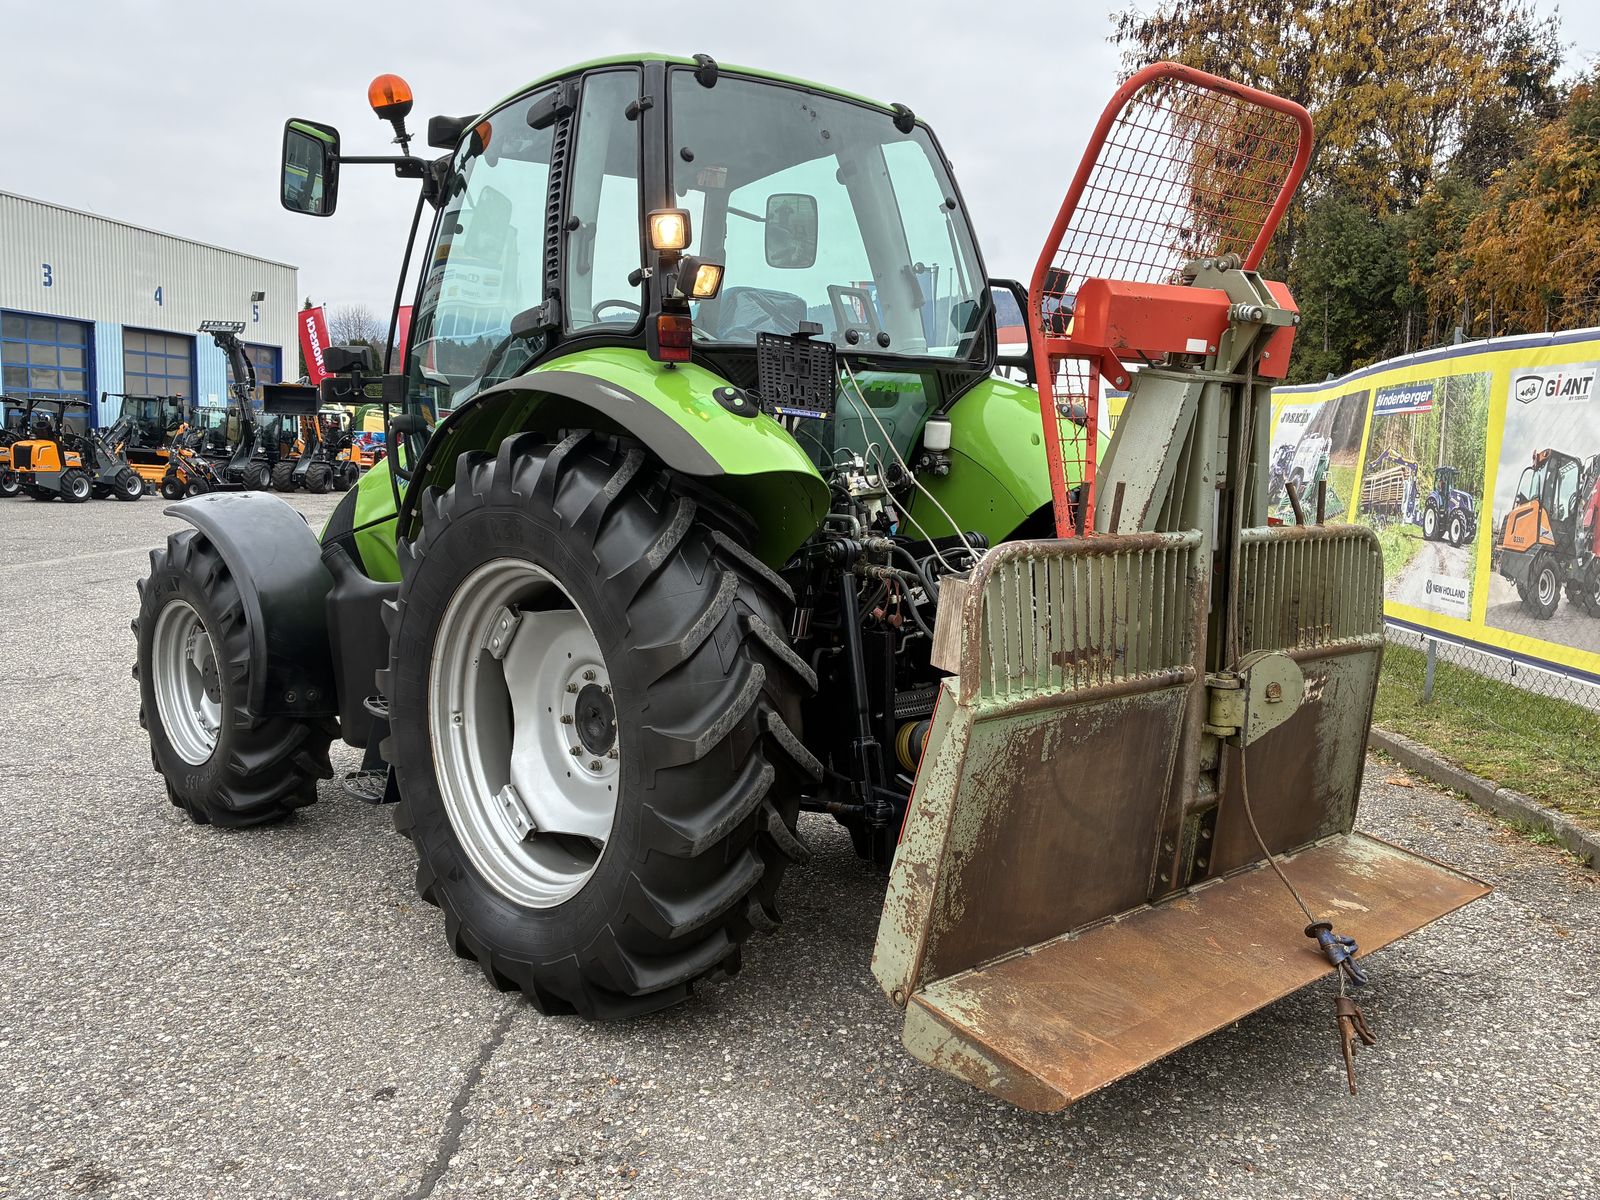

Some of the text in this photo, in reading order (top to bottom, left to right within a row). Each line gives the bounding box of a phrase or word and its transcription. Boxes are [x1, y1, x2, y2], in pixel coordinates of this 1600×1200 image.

[42, 264, 52, 287] 3
[154, 286, 163, 306] 4
[253, 305, 259, 323] 5
[1376, 390, 1431, 406] Binderberger
[1433, 584, 1465, 599] NEW HOLLAND
